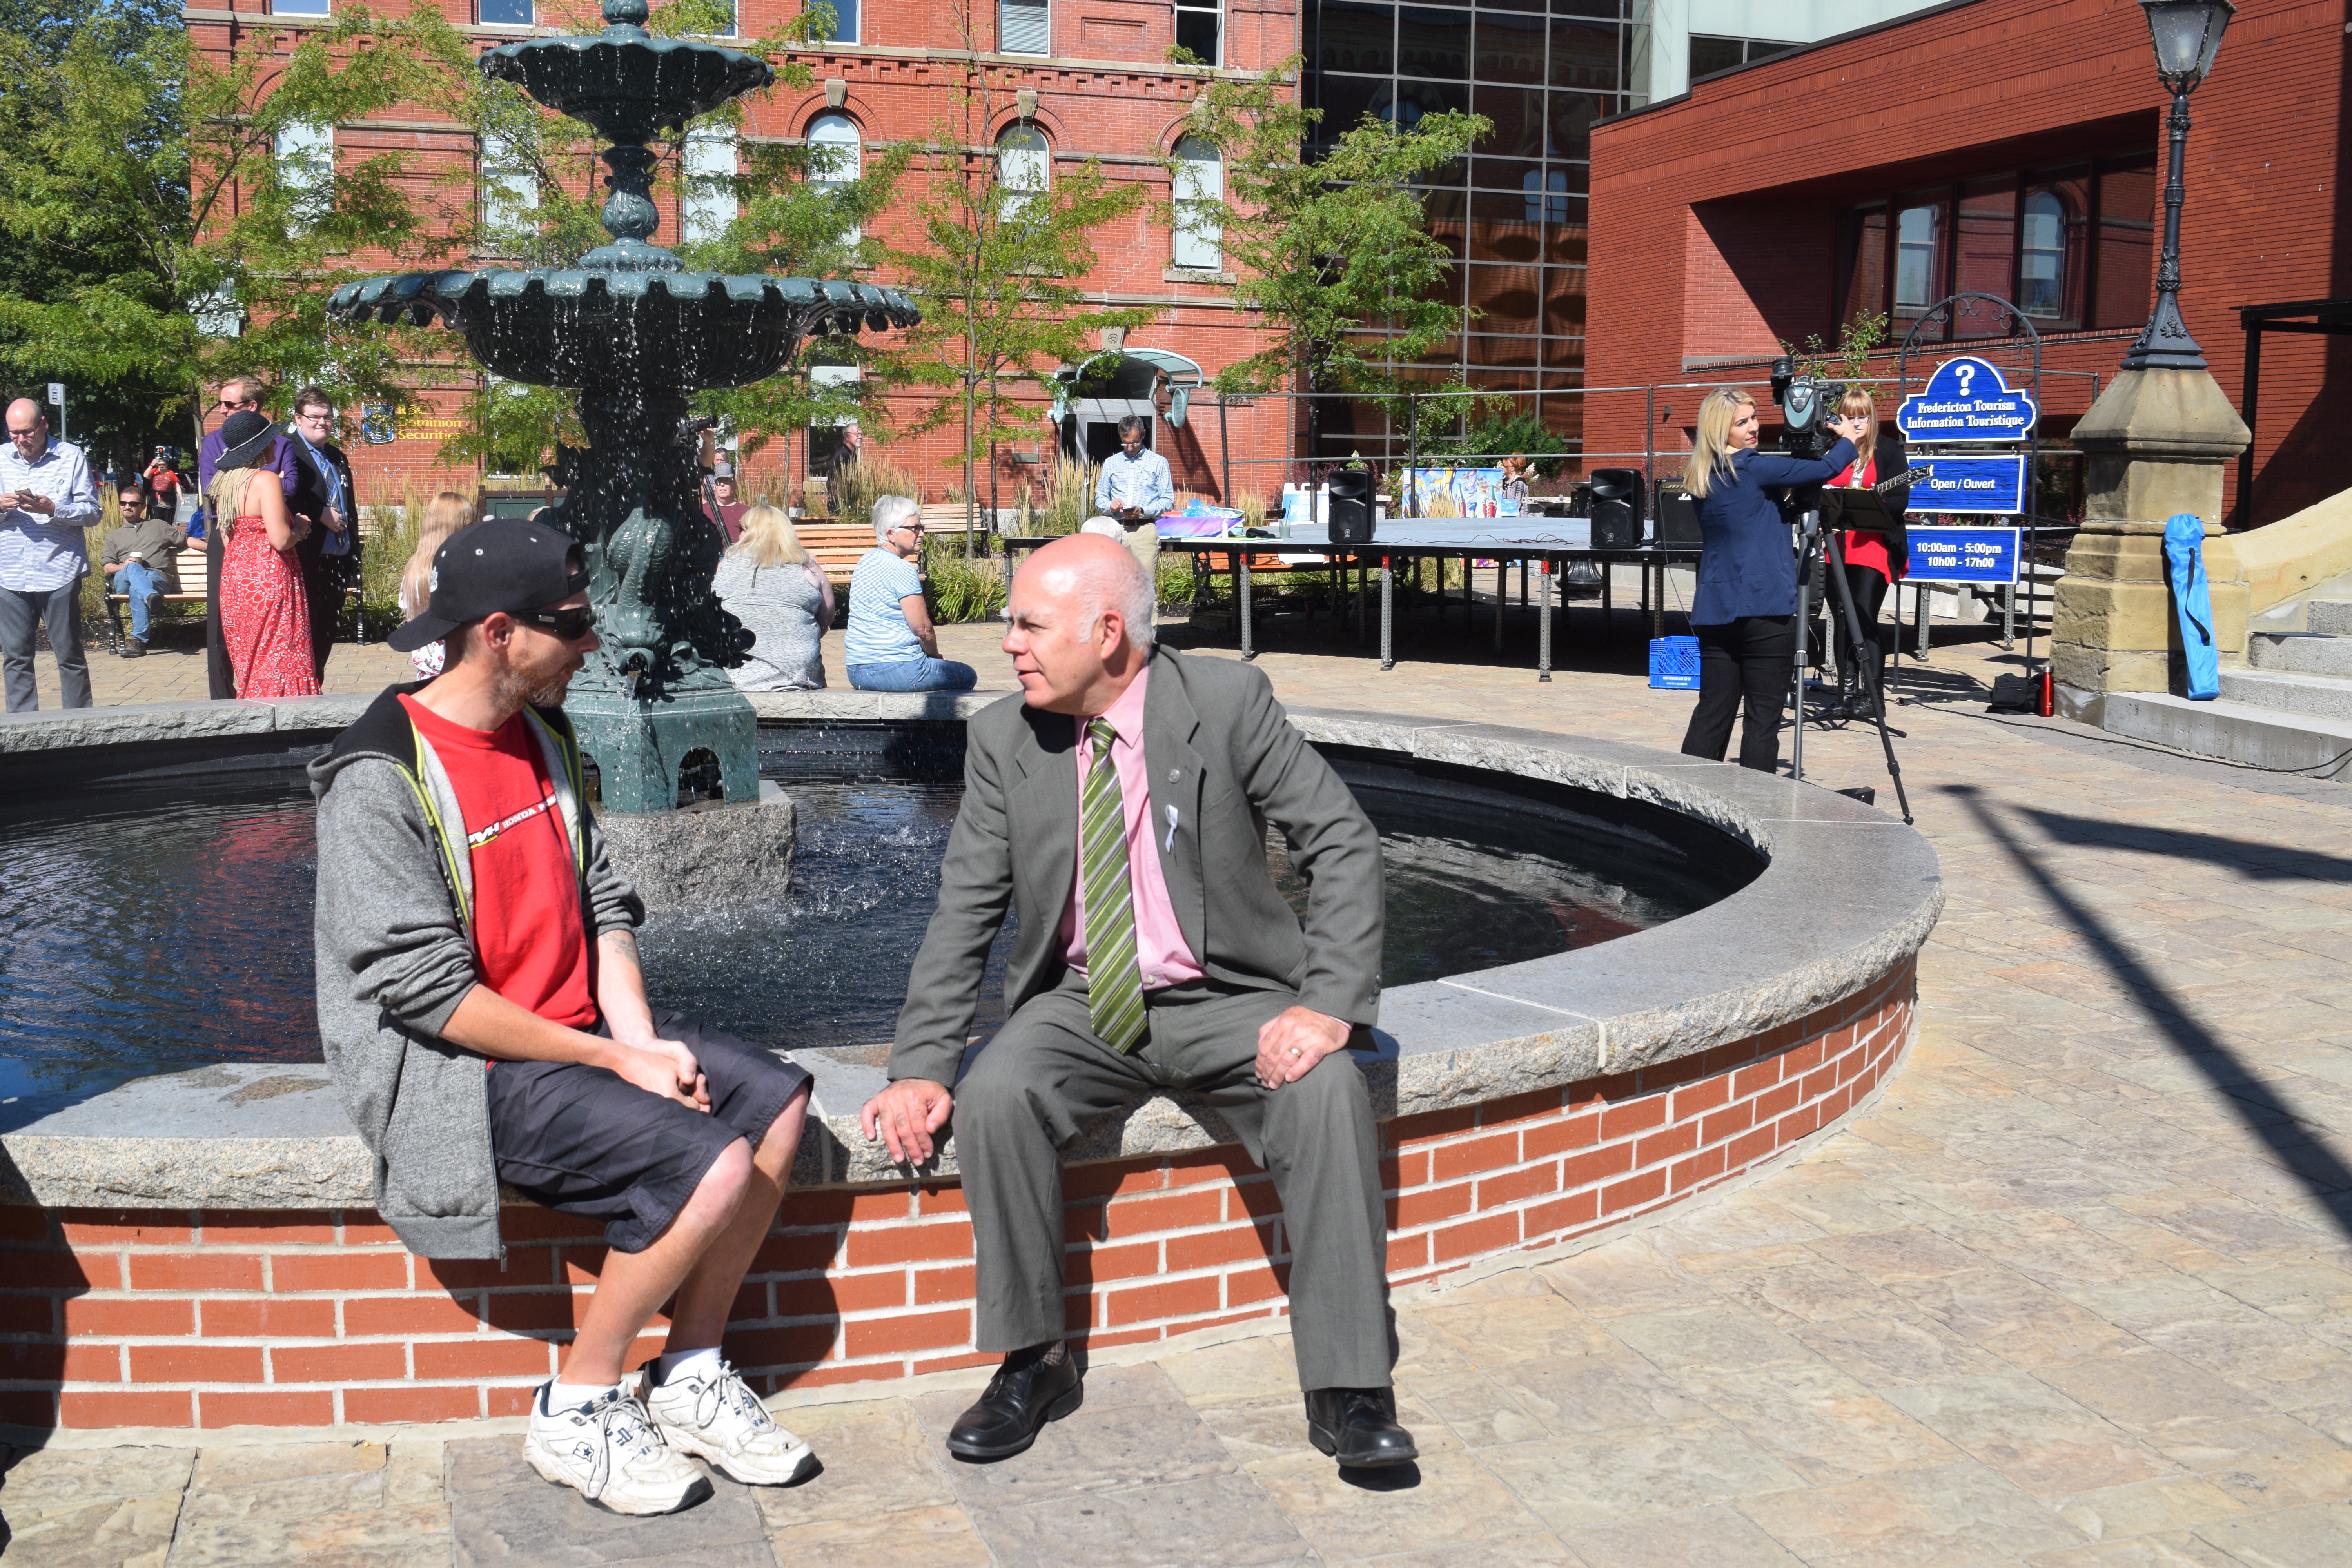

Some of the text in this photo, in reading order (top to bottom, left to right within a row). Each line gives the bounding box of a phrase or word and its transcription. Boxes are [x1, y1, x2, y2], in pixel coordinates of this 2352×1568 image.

[1918, 399, 2016, 414] Fredericton Tourism
[1907, 414, 2024, 428] Information Touristique
[398, 430, 461, 440] Securities
[1931, 479, 1955, 491] Open
[1964, 479, 1995, 489] Ouvert
[1290, 505, 1321, 516] PIA
[1917, 543, 1956, 552] 10:00am
[1965, 543, 2002, 555] 5:00pm
[1928, 557, 1956, 567] 10h00
[1965, 557, 1994, 568] 17h00
[502, 808, 537, 829] HONDA
